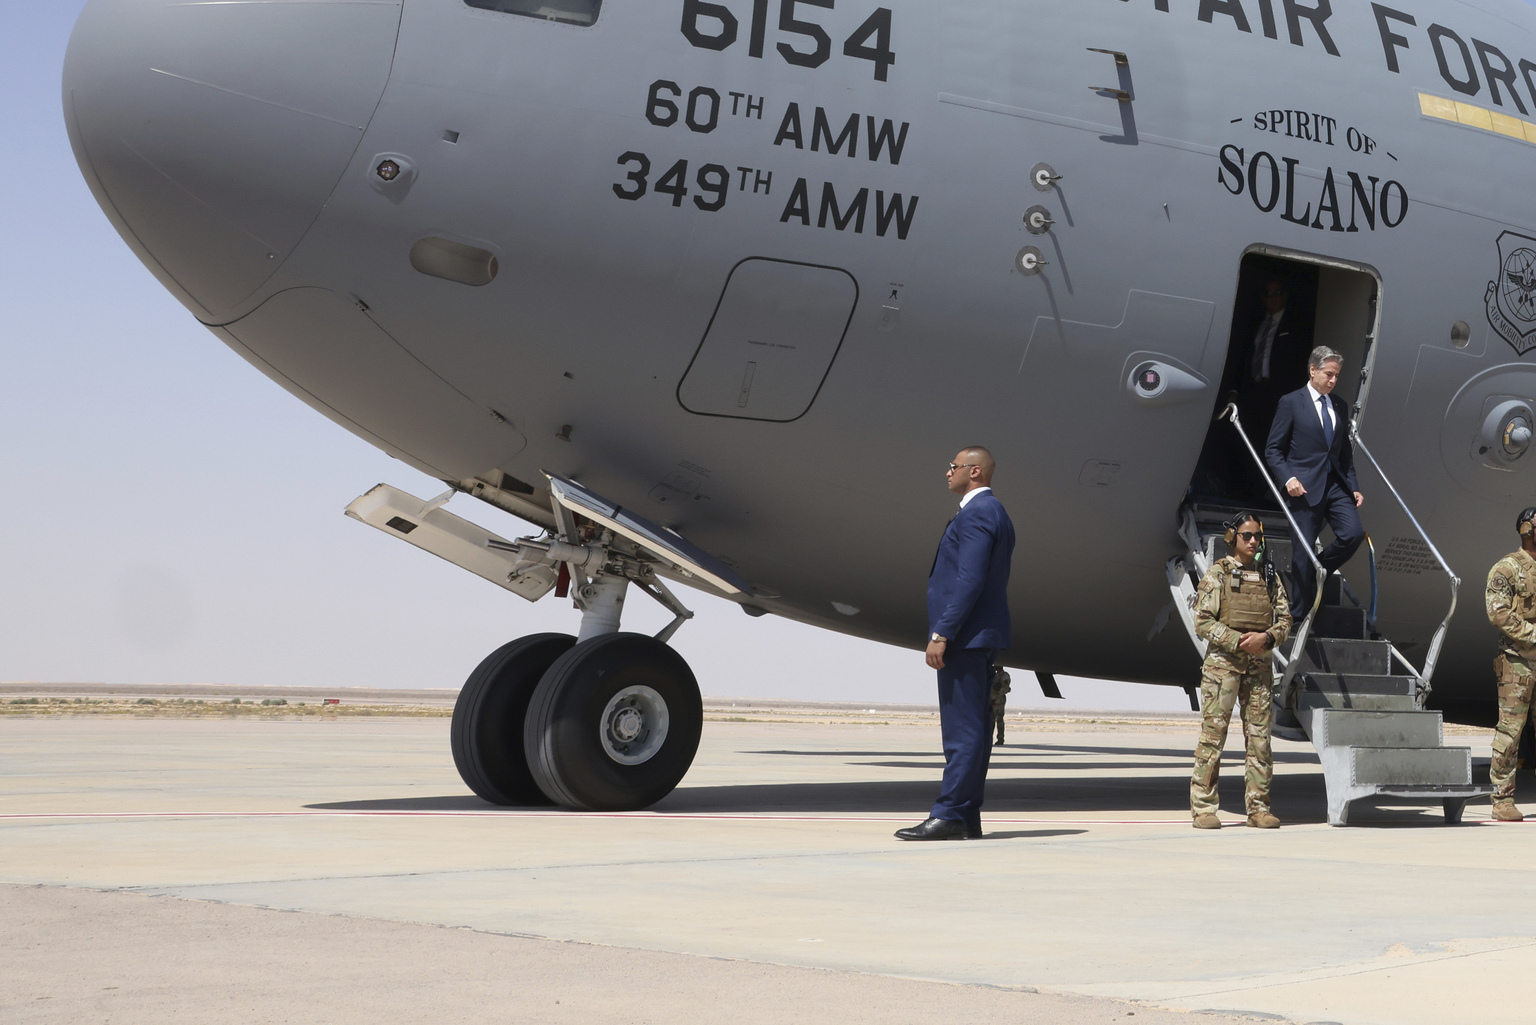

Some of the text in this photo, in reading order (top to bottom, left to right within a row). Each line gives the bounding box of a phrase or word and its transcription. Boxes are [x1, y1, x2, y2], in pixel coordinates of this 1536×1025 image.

[773, 102, 910, 165] AMW
[1252, 108, 1377, 155] SPIRIT OF
[780, 177, 919, 241] AMW
[1217, 143, 1409, 233] SOLANO
[1490, 305, 1501, 324] AIR
[1498, 320, 1526, 350] MOBILITY
